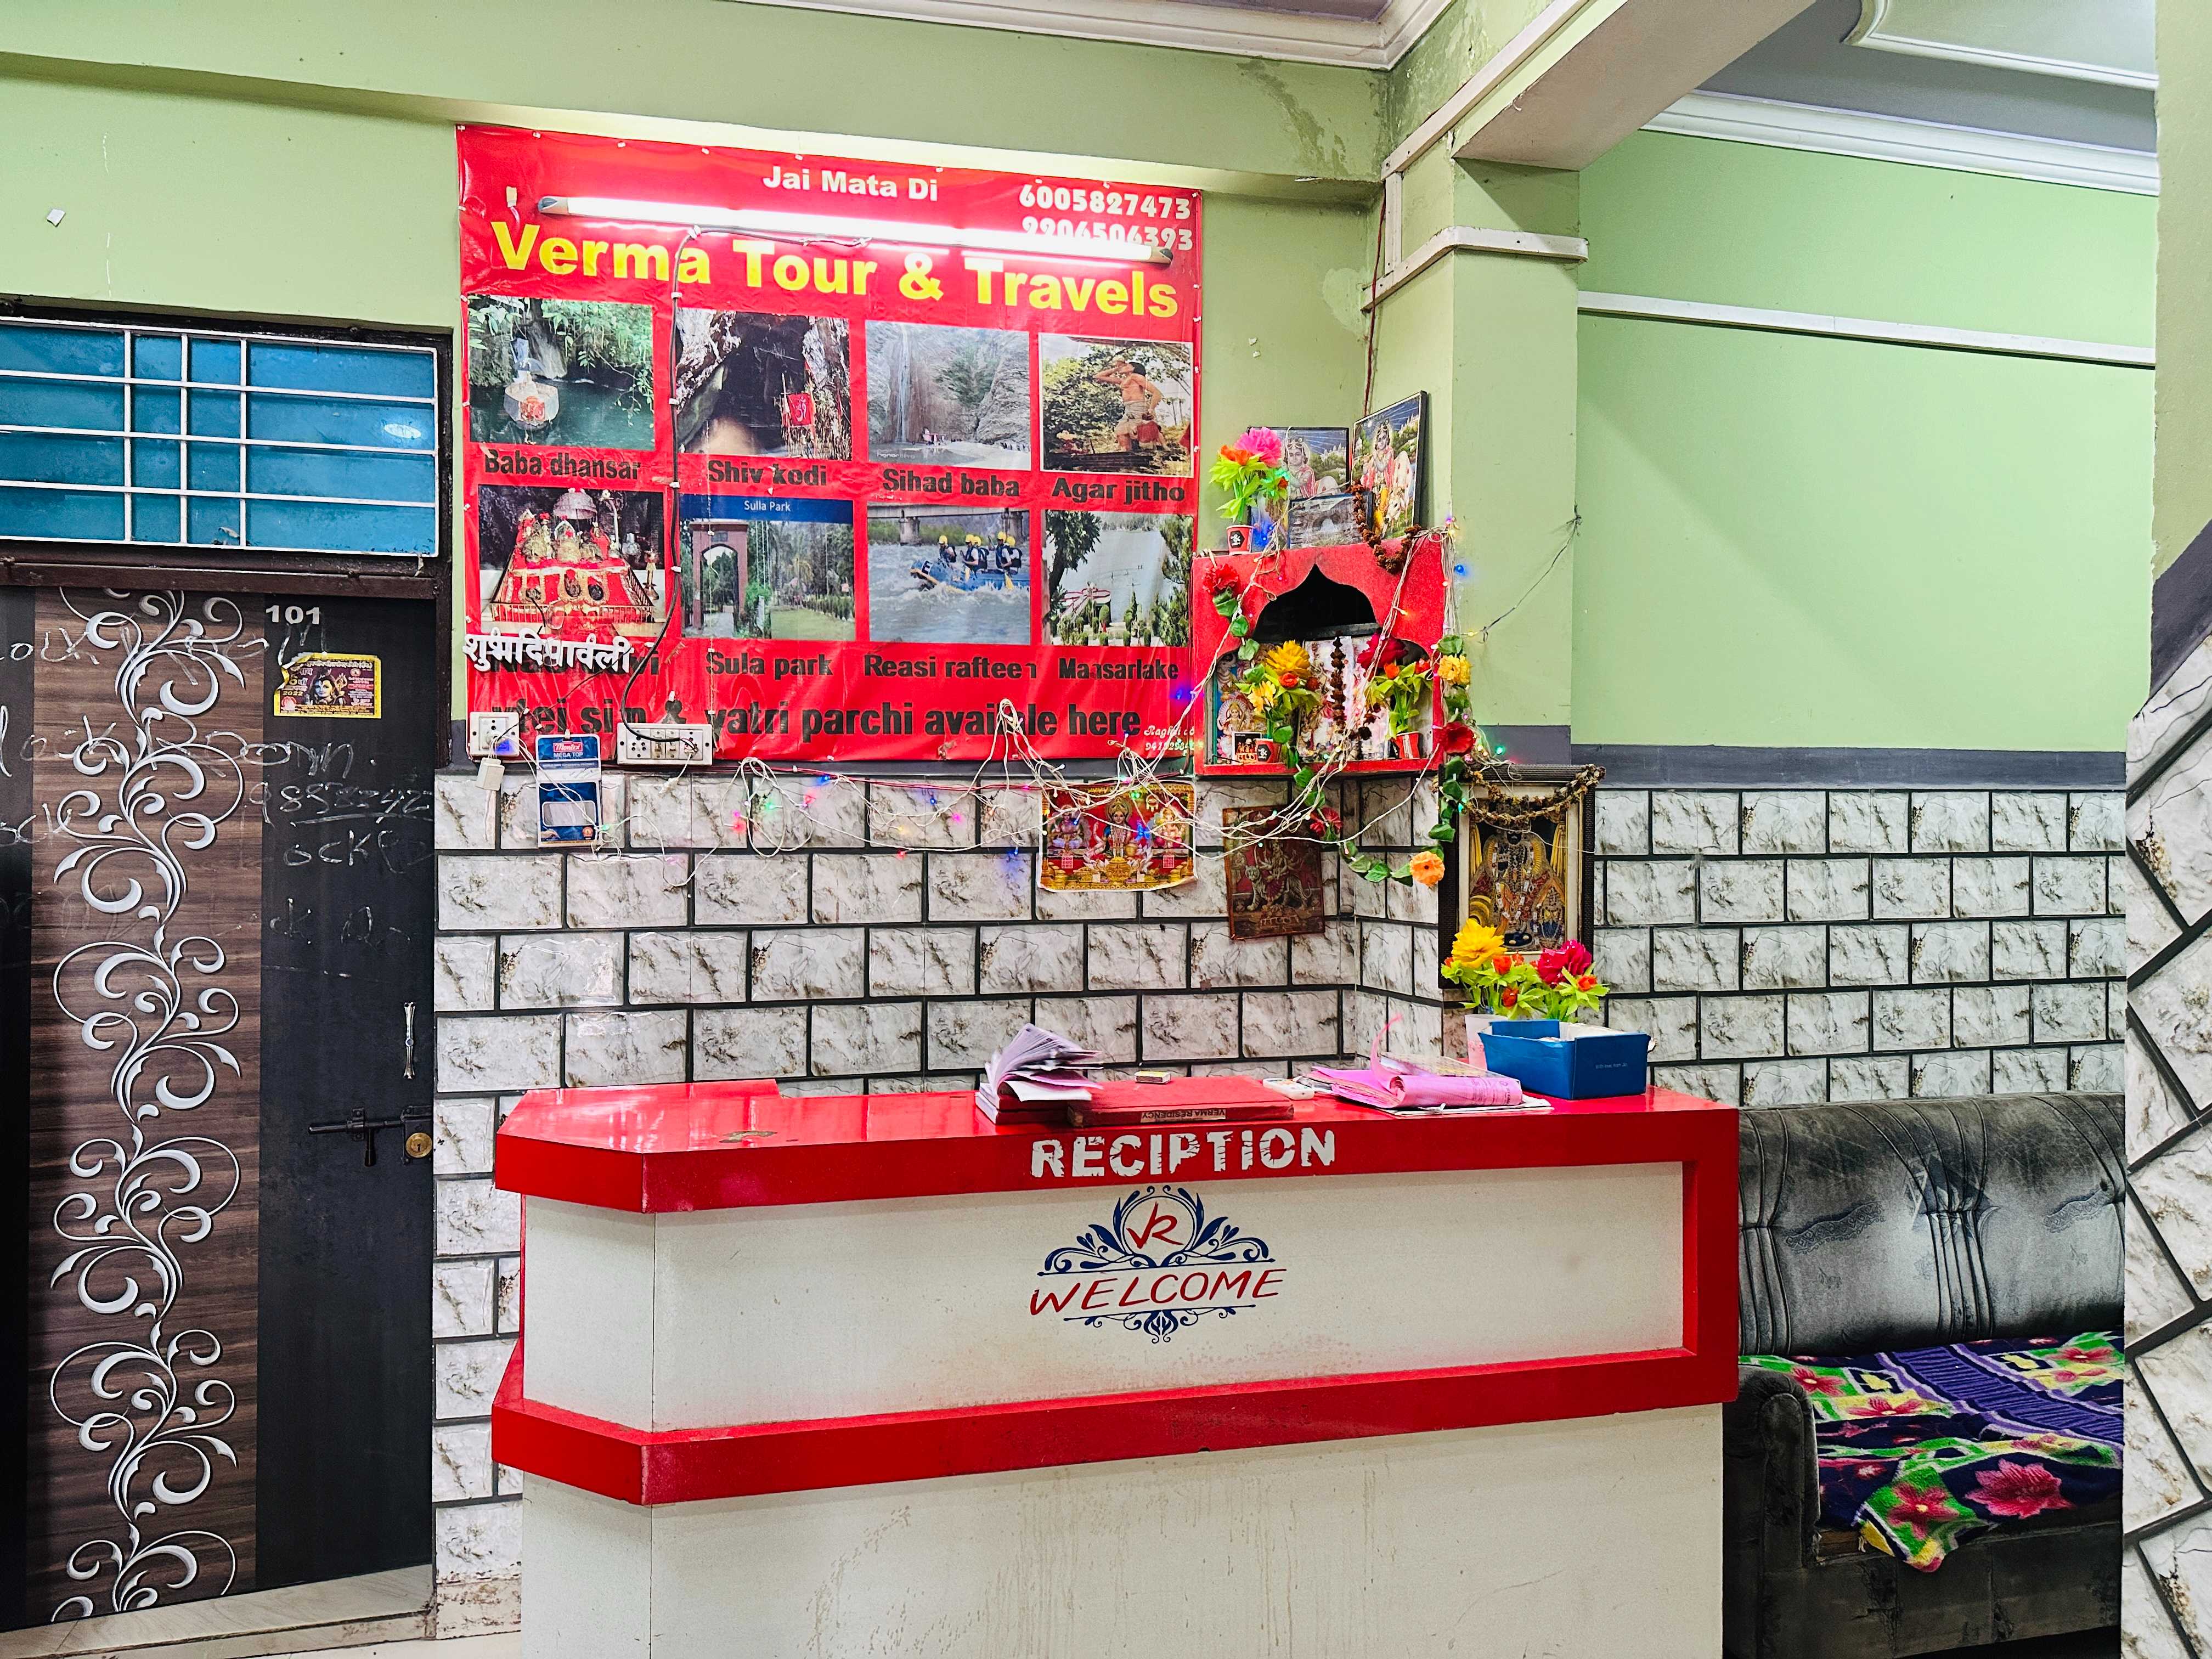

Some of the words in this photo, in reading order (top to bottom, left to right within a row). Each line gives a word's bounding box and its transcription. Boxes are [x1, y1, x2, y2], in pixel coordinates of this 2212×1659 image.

[762, 166, 810, 190] Jai
[821, 170, 898, 198] Mata
[909, 177, 938, 201] Di
[1019, 184, 1190, 219] 6005827473
[490, 221, 711, 284] Verma
[732, 239, 878, 295] Tour
[899, 253, 944, 301] &
[964, 256, 1178, 318] Travels
[485, 449, 542, 475] Baba
[707, 460, 764, 483] Shiv
[772, 463, 827, 486] kodi
[882, 468, 952, 494] Sihad
[961, 475, 1019, 496] baba
[1052, 478, 1118, 503] Agar
[1124, 481, 1185, 505] jitho
[744, 500, 767, 511] Sulla
[769, 501, 791, 512] Park
[266, 605, 320, 625] 101
[706, 651, 765, 675] Sula
[774, 653, 833, 680] park
[864, 654, 936, 678] Reasi
[802, 702, 913, 743] parchi
[1067, 703, 1141, 736] here
[1142, 1110, 1193, 1119] RESIDENCY
[1031, 1127, 1335, 1179] RECIPTION
[1030, 1268, 1288, 1317] WELCOME
